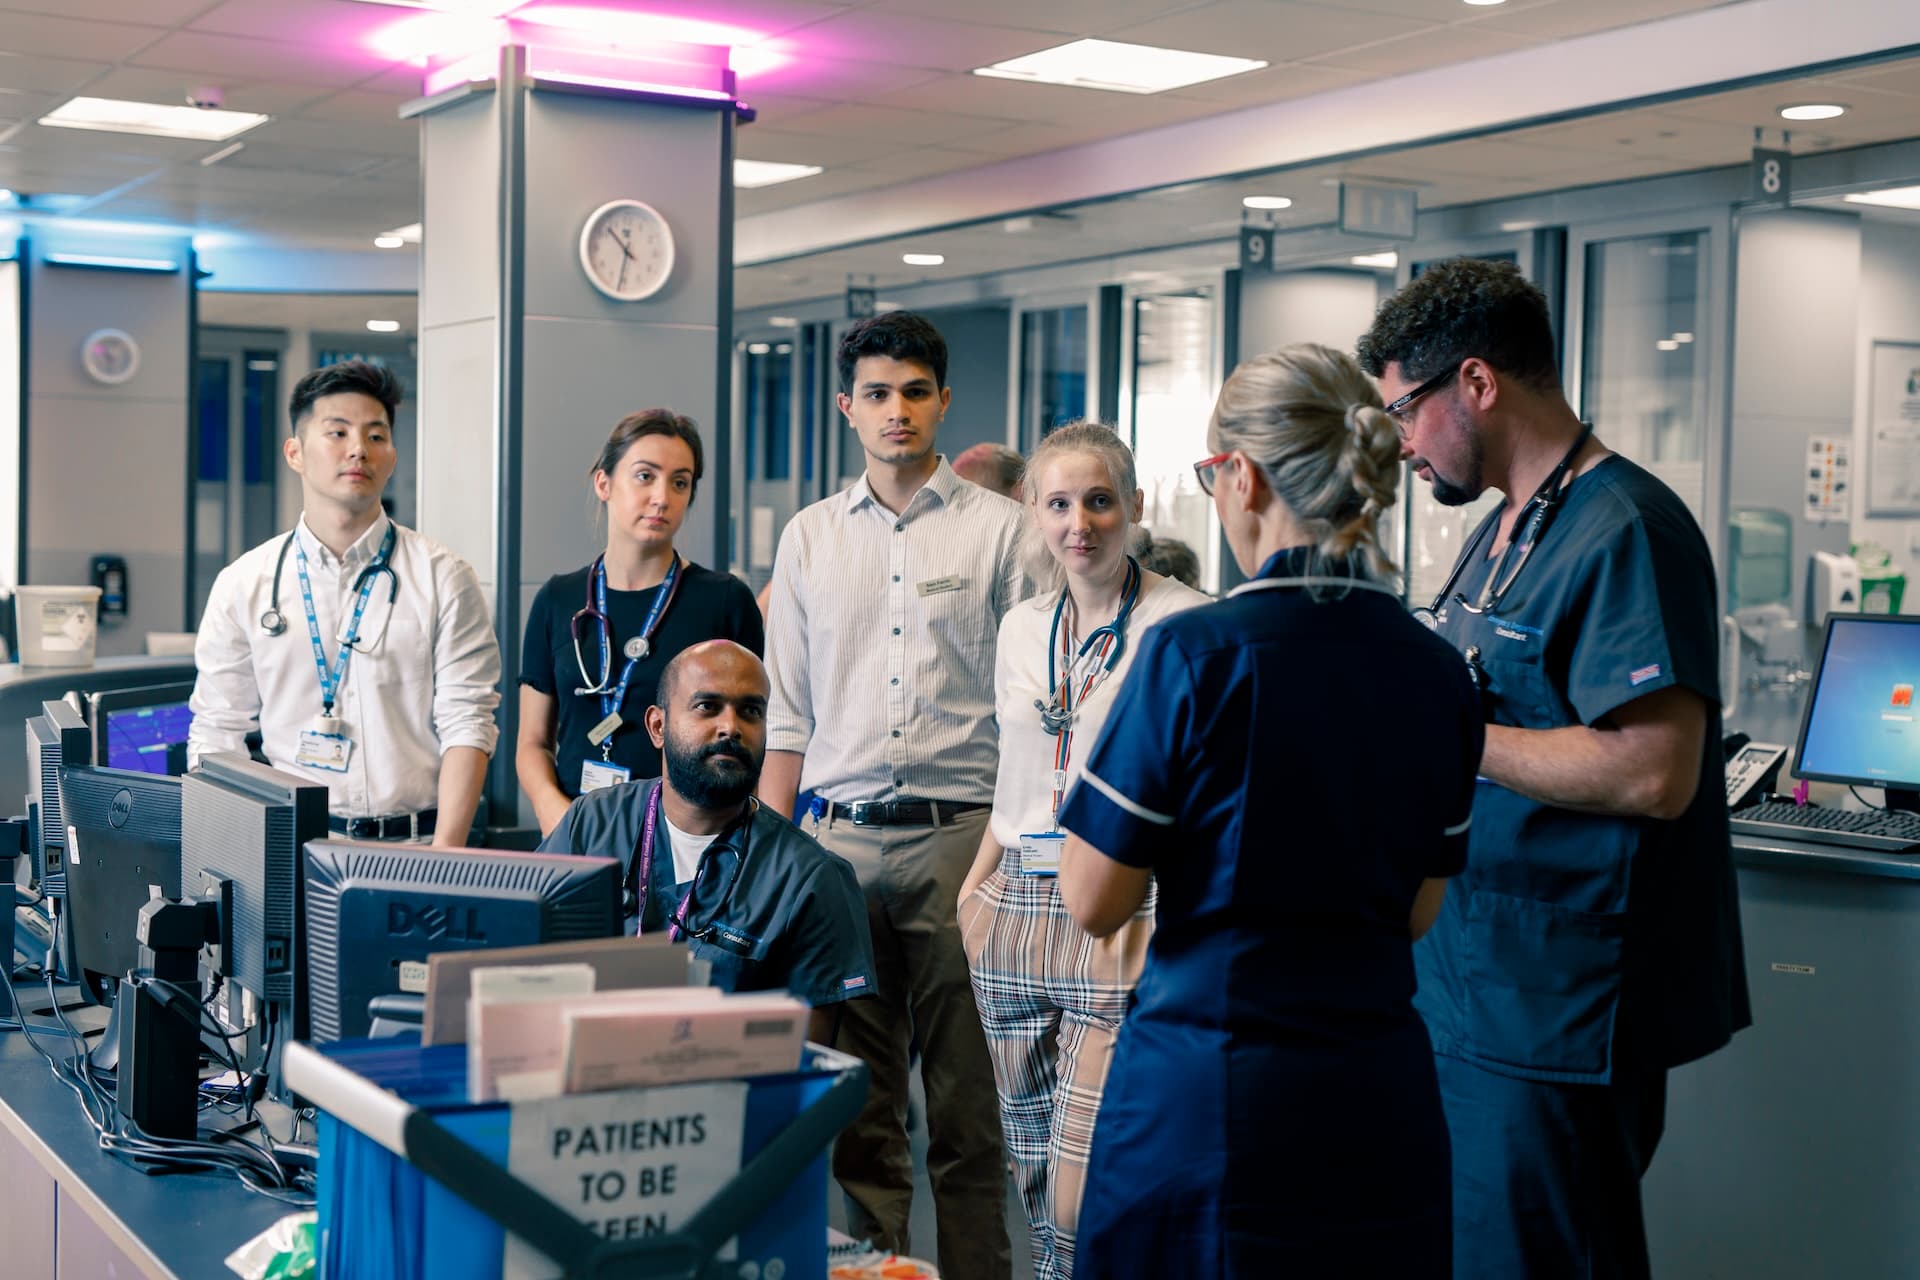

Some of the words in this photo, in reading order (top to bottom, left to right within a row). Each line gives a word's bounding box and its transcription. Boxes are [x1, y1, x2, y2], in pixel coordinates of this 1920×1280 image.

[1763, 160, 1780, 193] 8
[1249, 235, 1265, 262] 9
[642, 830, 651, 856] Emergency
[388, 902, 488, 944] DELL
[553, 1113, 706, 1159] PATIENTS
[580, 1171, 625, 1204] TO
[640, 1163, 677, 1197] BE
[586, 1212, 667, 1240] EEN
